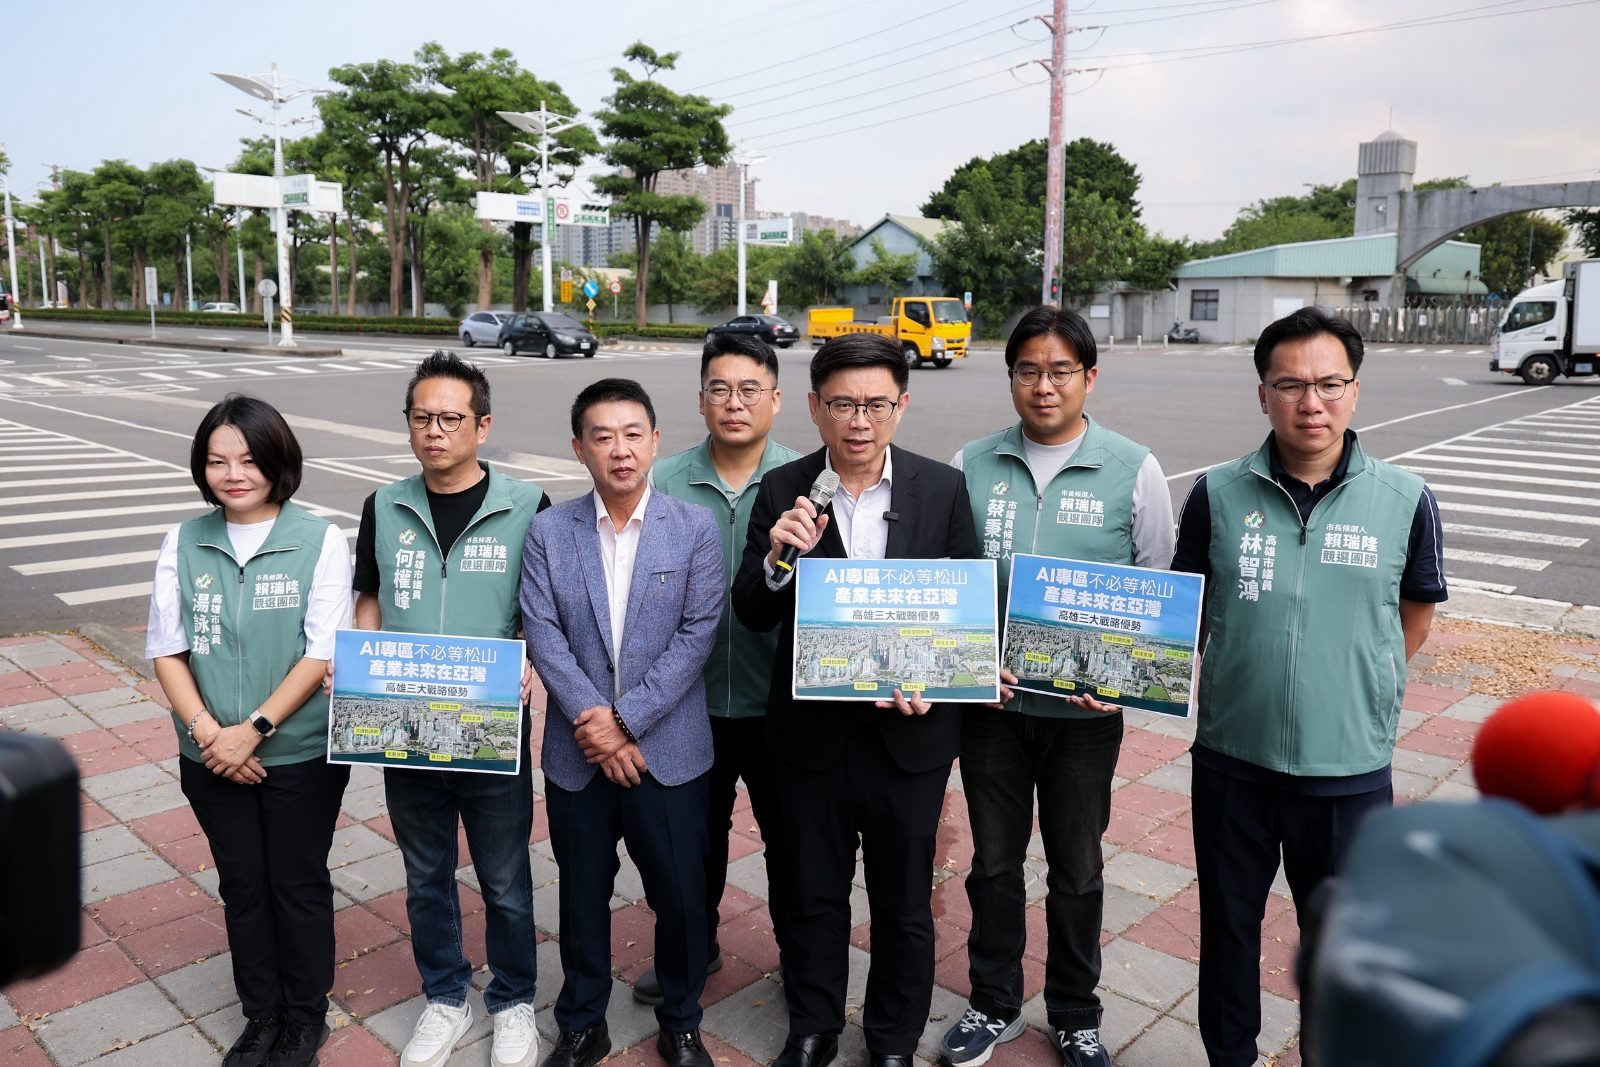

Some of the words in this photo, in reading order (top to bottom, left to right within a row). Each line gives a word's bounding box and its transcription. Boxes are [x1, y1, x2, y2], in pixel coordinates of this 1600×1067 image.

[1061, 490, 1095, 499] 市長候選人
[1060, 498, 1104, 513] 賴瑞隆
[1058, 512, 1104, 526] 競選團隊
[1326, 523, 1367, 534] 市長候選人
[1002, 501, 1018, 560] 市議員候選人
[463, 544, 507, 559] 賴瑞隆
[1324, 532, 1378, 552] 賴瑞隆
[461, 560, 506, 572] 競選團隊
[1238, 533, 1263, 602] 林智鴻
[1262, 535, 1277, 592] 高雄市議員
[1321, 549, 1378, 567] 競選團隊
[255, 573, 290, 581] 市長候選人
[393, 548, 415, 610] 何權峰
[412, 550, 426, 600] 高雄市議員
[824, 568, 968, 585] AI專區不必等松山
[1035, 566, 1174, 599] AI專區不必等松山
[254, 580, 300, 597] 賴瑞隆
[834, 586, 958, 606] 產業未來在亞灣
[1043, 585, 1162, 618] 產業未來在亞灣
[192, 593, 210, 655] 湯詠瑜
[211, 594, 223, 645] 高雄市議員
[852, 609, 940, 622] 高雄三大戰略優勢
[1058, 610, 1142, 631] 高雄三大戰略優勢
[359, 640, 497, 664] AI專區不必等松山
[369, 659, 487, 683] 產業未來在亞灣
[385, 682, 468, 697] 高雄三大戰略優勢
[986, 1019, 1007, 1036] N
